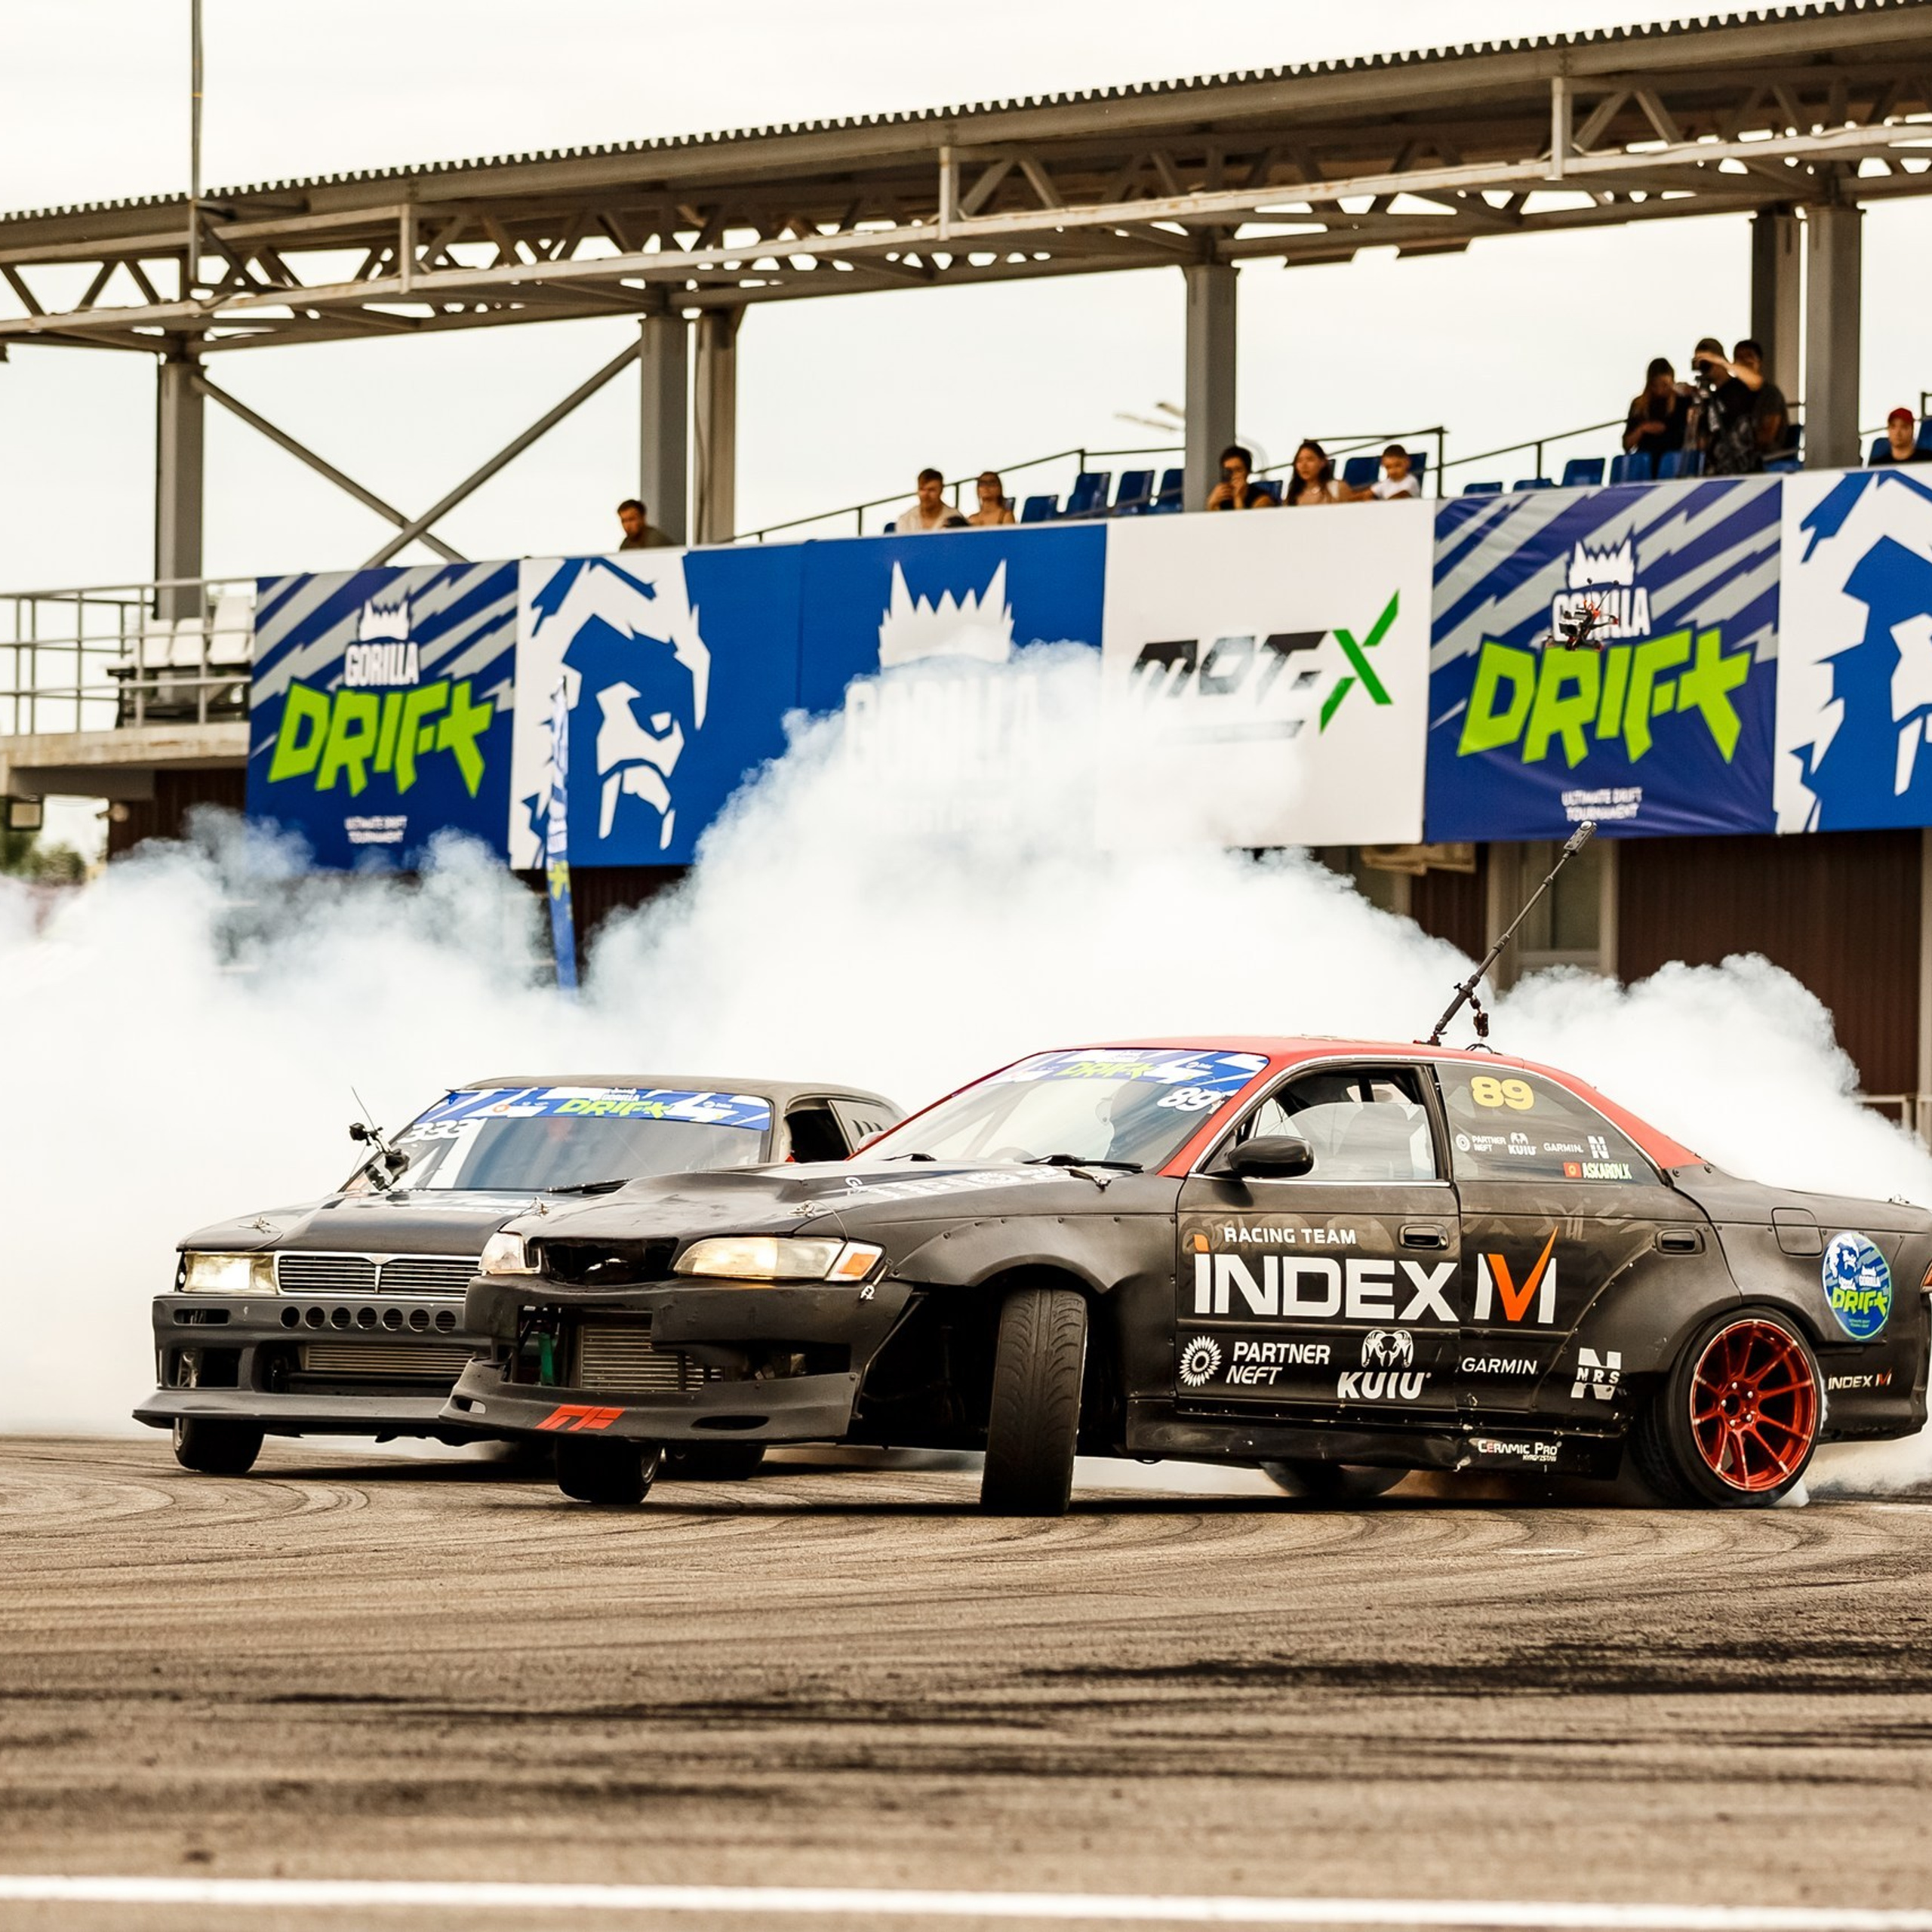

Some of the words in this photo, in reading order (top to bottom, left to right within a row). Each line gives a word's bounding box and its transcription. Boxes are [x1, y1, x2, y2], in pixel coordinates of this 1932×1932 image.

[345, 641, 420, 687] GORILLA
[1156, 1087, 1223, 1112] 89
[1470, 1076, 1535, 1110] 89
[1472, 1135, 1507, 1145] PARTNER
[1473, 1143, 1493, 1152] NEFT
[1508, 1144, 1537, 1156] KUIU
[1543, 1142, 1583, 1153] GARMIN
[1223, 1226, 1297, 1244] RACING
[1300, 1228, 1357, 1245] TEAM
[1194, 1233, 1460, 1322] INDEX
[1232, 1341, 1331, 1365] PARTNER
[1226, 1365, 1284, 1386] NEFT
[1461, 1357, 1538, 1376] GARMIN
[1337, 1371, 1426, 1401] KUIU
[1828, 1374, 1874, 1390] INDEX
